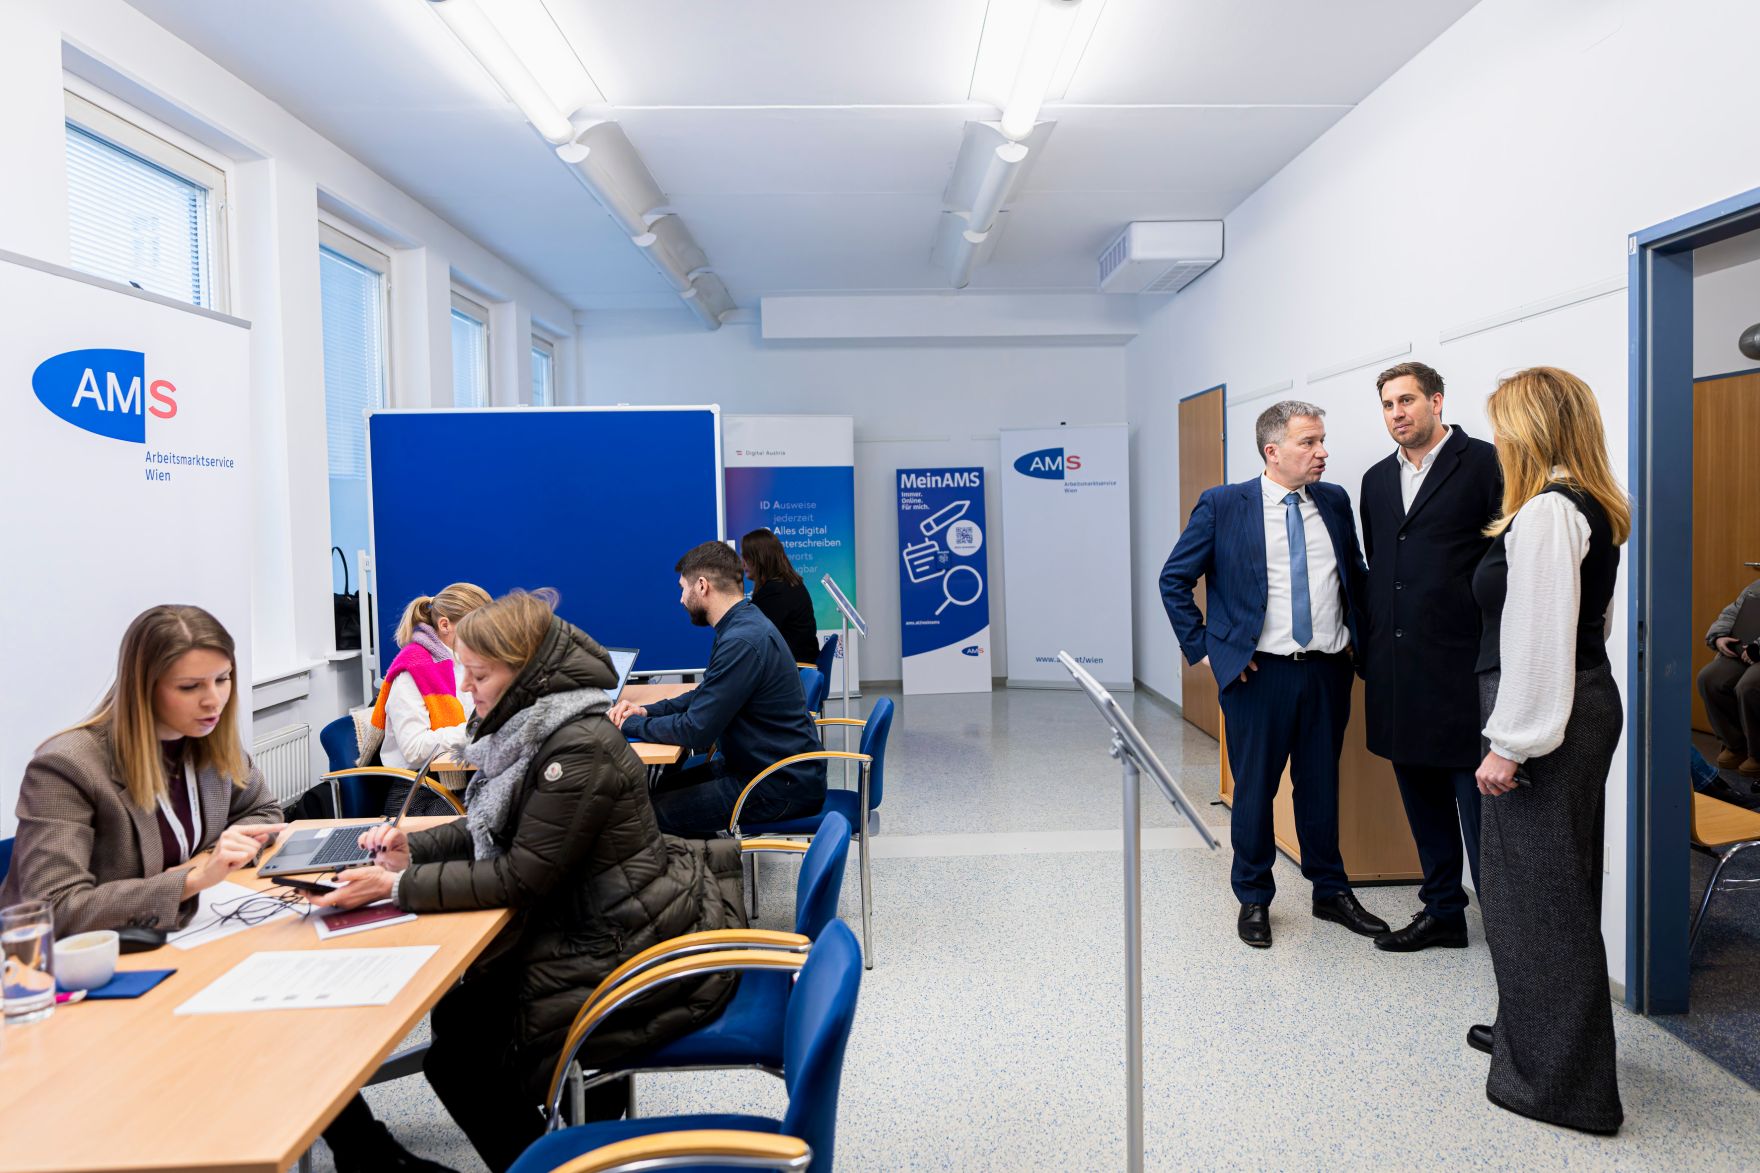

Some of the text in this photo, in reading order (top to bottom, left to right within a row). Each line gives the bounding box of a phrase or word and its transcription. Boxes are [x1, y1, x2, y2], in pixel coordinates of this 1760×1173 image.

[71, 367, 178, 419] AMS
[145, 450, 235, 469] Arbeitsmarktservice
[745, 449, 765, 457] Digital
[1029, 455, 1082, 471] AMS
[145, 468, 171, 482] Wien
[901, 471, 980, 489] MeinAMS
[760, 500, 817, 510] ID Ausweise
[902, 503, 912, 511] Für
[773, 513, 814, 525] jederzeit
[773, 525, 796, 536] Alles
[798, 524, 827, 537] digital
[781, 538, 842, 549] nterschreiben
